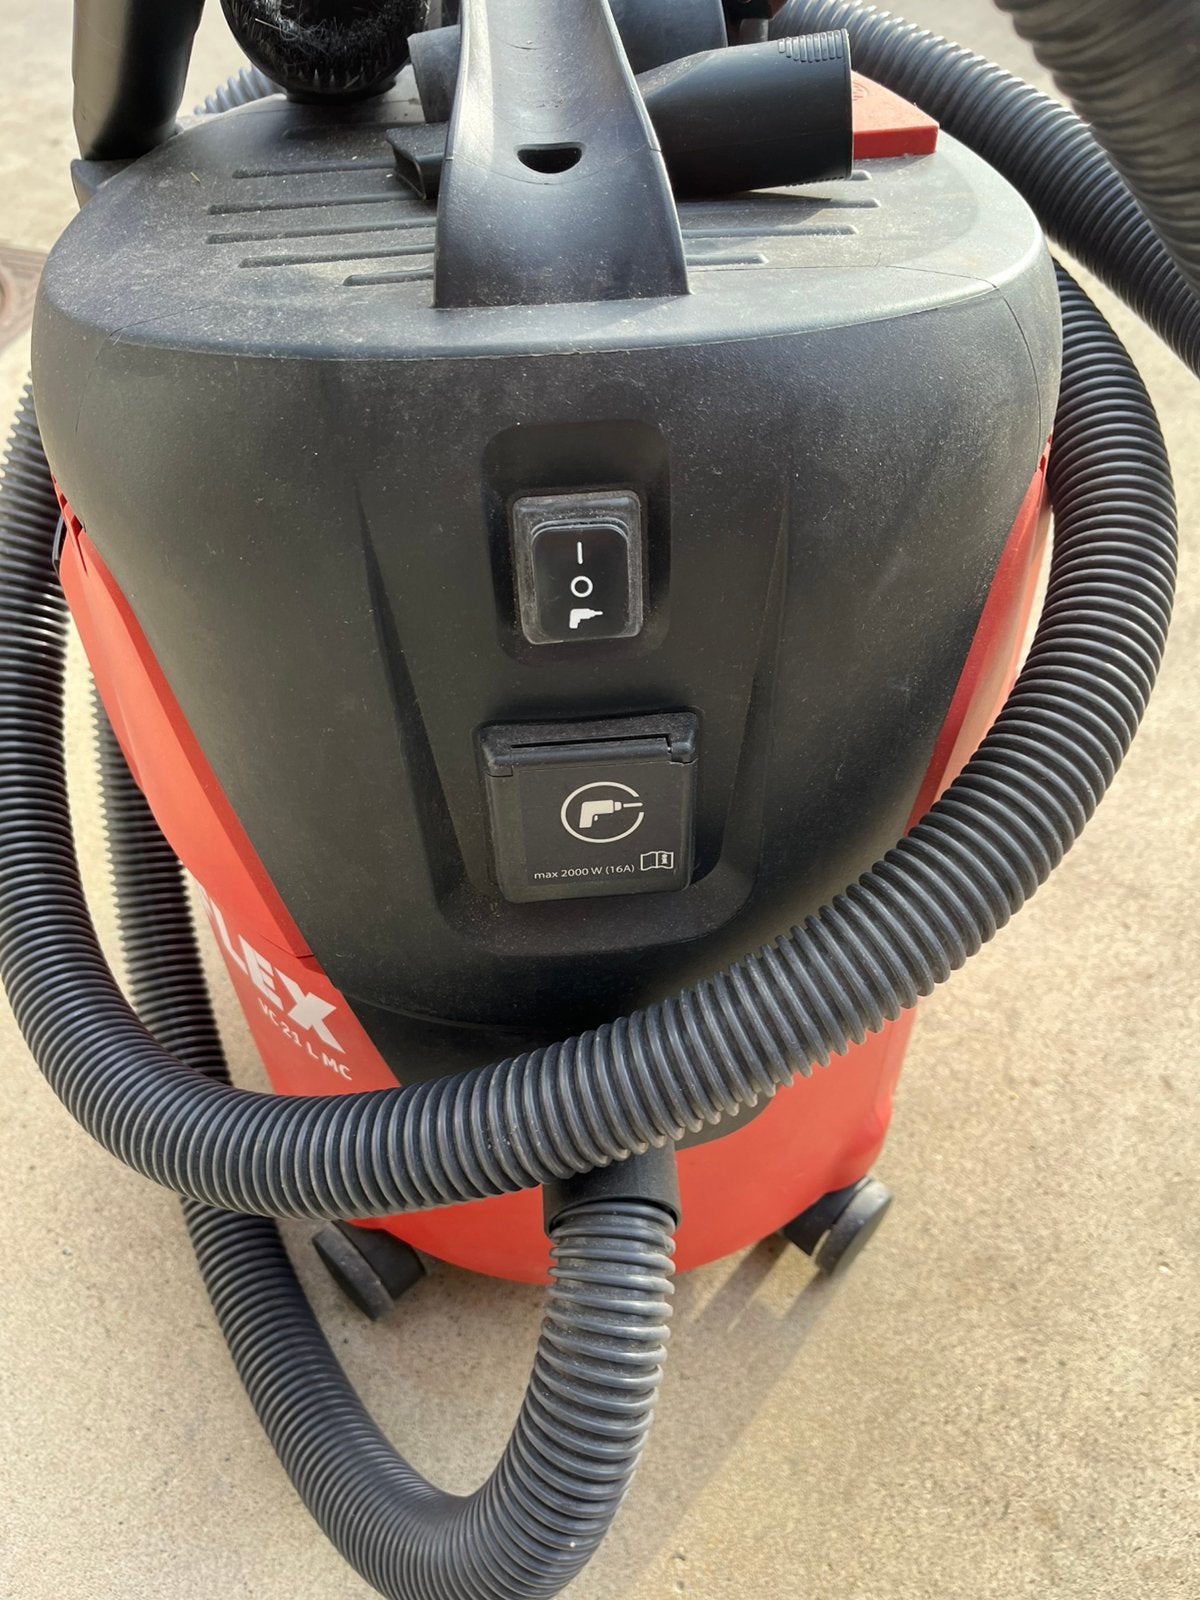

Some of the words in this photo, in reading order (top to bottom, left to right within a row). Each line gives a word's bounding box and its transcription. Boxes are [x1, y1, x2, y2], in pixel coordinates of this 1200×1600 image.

[534, 871, 559, 879] max
[560, 867, 589, 878] 2000
[590, 866, 603, 875] W
[605, 864, 635, 875] (16A)
[306, 1041, 320, 1060] L
[321, 1052, 353, 1081] MC
